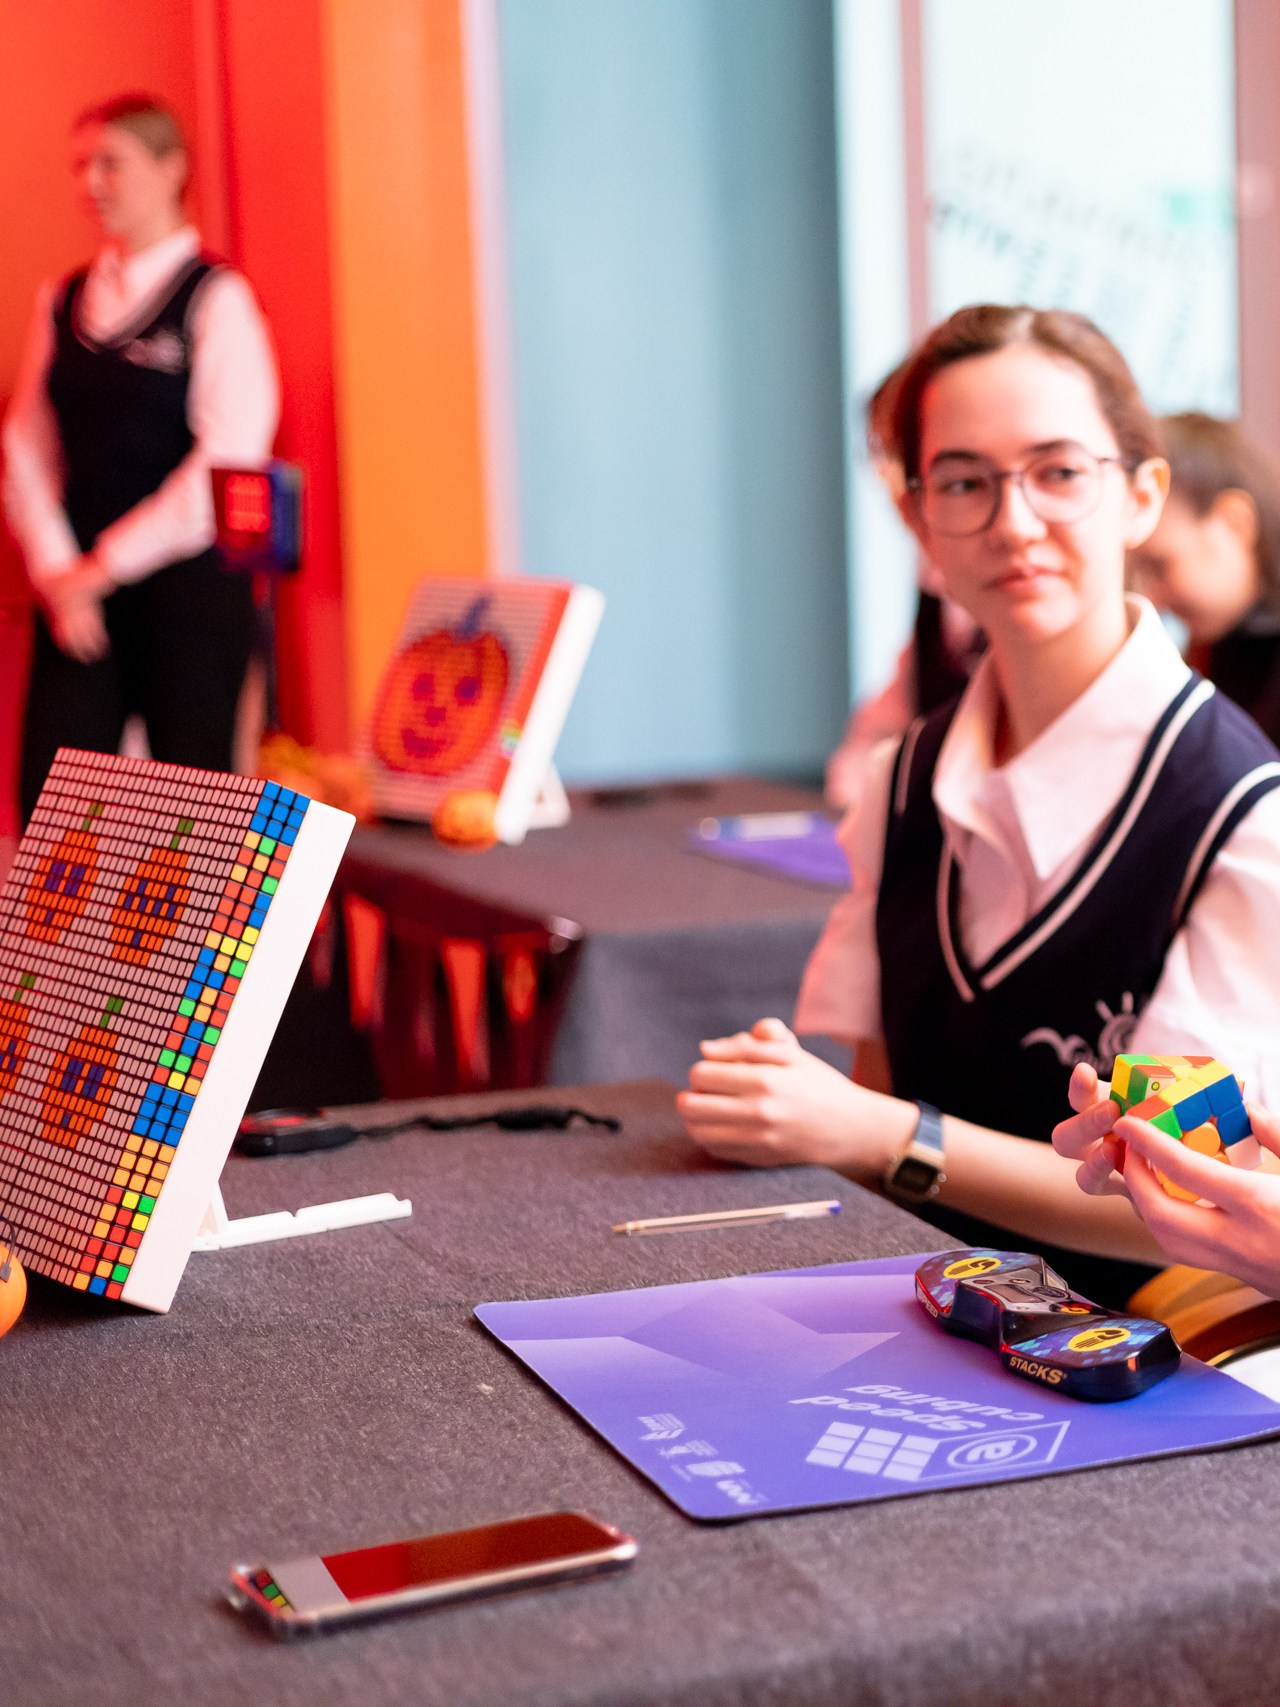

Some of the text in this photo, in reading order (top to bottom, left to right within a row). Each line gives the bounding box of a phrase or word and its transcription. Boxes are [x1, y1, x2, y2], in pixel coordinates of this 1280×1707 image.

[1009, 1356, 1063, 1385] STACKS
[788, 1395, 987, 1431] Speed
[843, 1384, 1045, 1421] cubing
